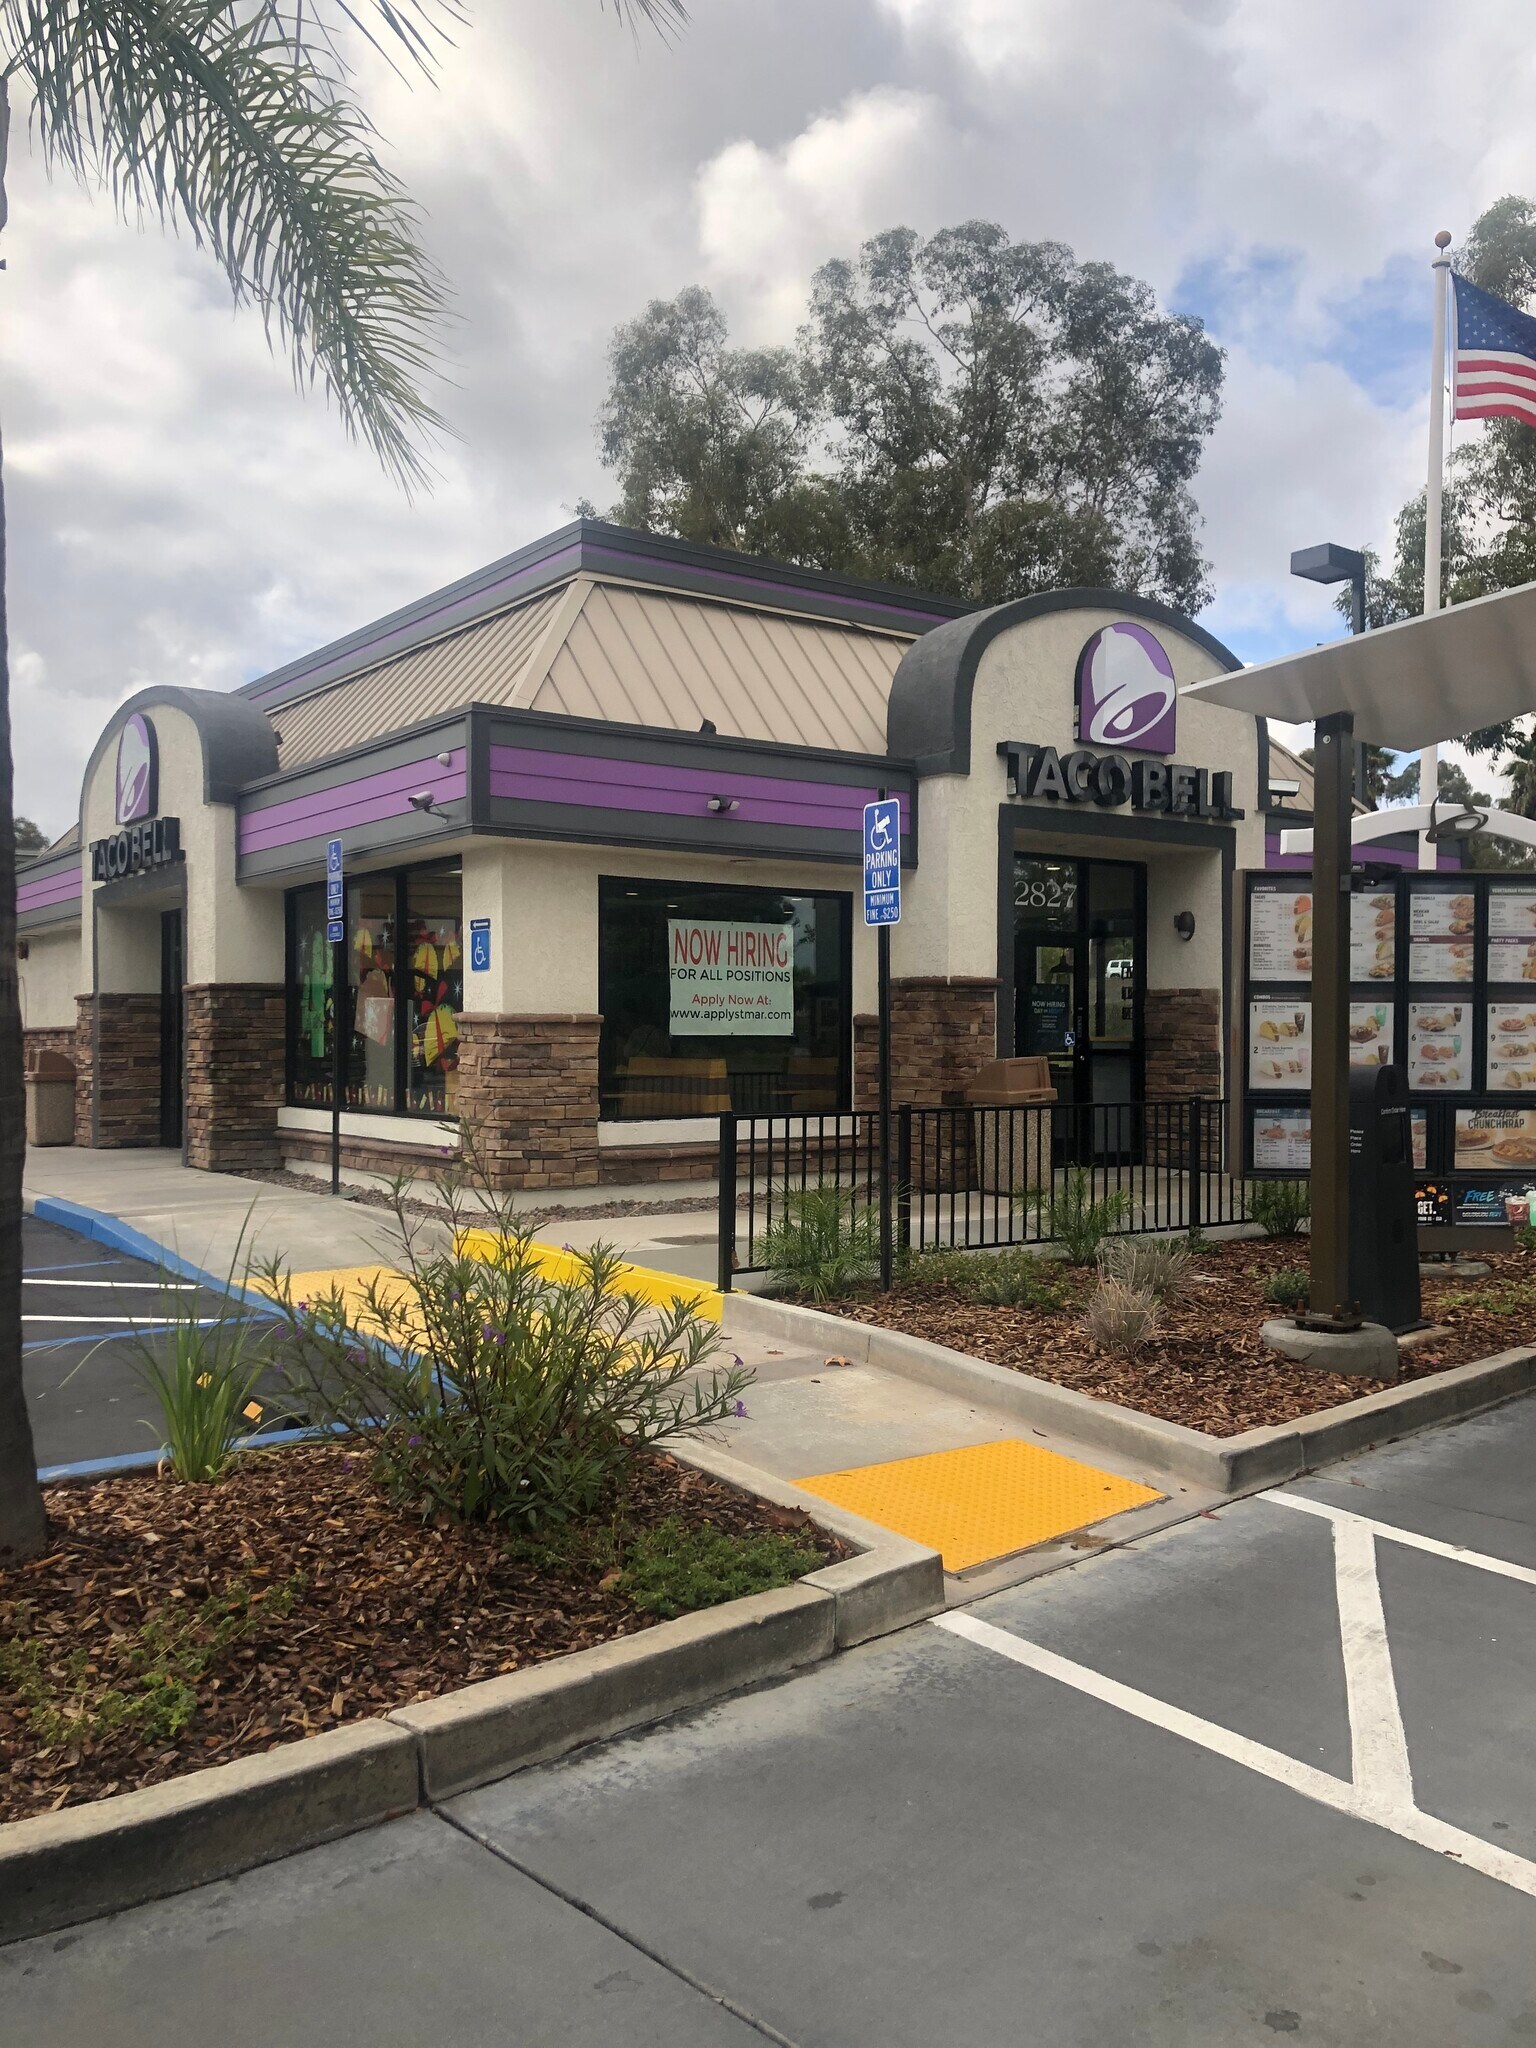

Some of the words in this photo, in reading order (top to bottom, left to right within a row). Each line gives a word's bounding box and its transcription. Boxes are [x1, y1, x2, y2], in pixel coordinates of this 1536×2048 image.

[997, 740, 1134, 807] TACO
[1132, 760, 1246, 821] BELL
[89, 831, 132, 881] TACO
[131, 816, 186, 870] BELL
[866, 849, 898, 870] PARKING
[871, 869, 892, 889] ONLY
[870, 892, 894, 906] MINIMUM
[1014, 880, 1078, 909] 2827
[866, 908, 879, 921] FINE
[674, 928, 722, 966] NOW
[727, 930, 788, 968] HIRING
[670, 968, 697, 980] FOR
[700, 969, 723, 981] ALL
[727, 969, 791, 983] POSITIONS
[692, 994, 725, 1007] Apply
[728, 994, 754, 1005] Now
[757, 995, 772, 1006] At:
[670, 1008, 791, 1021] www.applystmar.com
[1411, 1005, 1417, 1013] 5
[1491, 1006, 1497, 1014] 8
[1411, 1033, 1416, 1041] 6
[1490, 1034, 1496, 1042] 9
[1253, 1046, 1259, 1054] 2
[1411, 1061, 1416, 1069] 7
[1490, 1062, 1498, 1070] 10
[1472, 1109, 1520, 1120] Breakfast
[1468, 1118, 1525, 1129] CRUNCHWRAP
[1464, 1190, 1495, 1203] FREE
[1417, 1201, 1437, 1215] GET.
